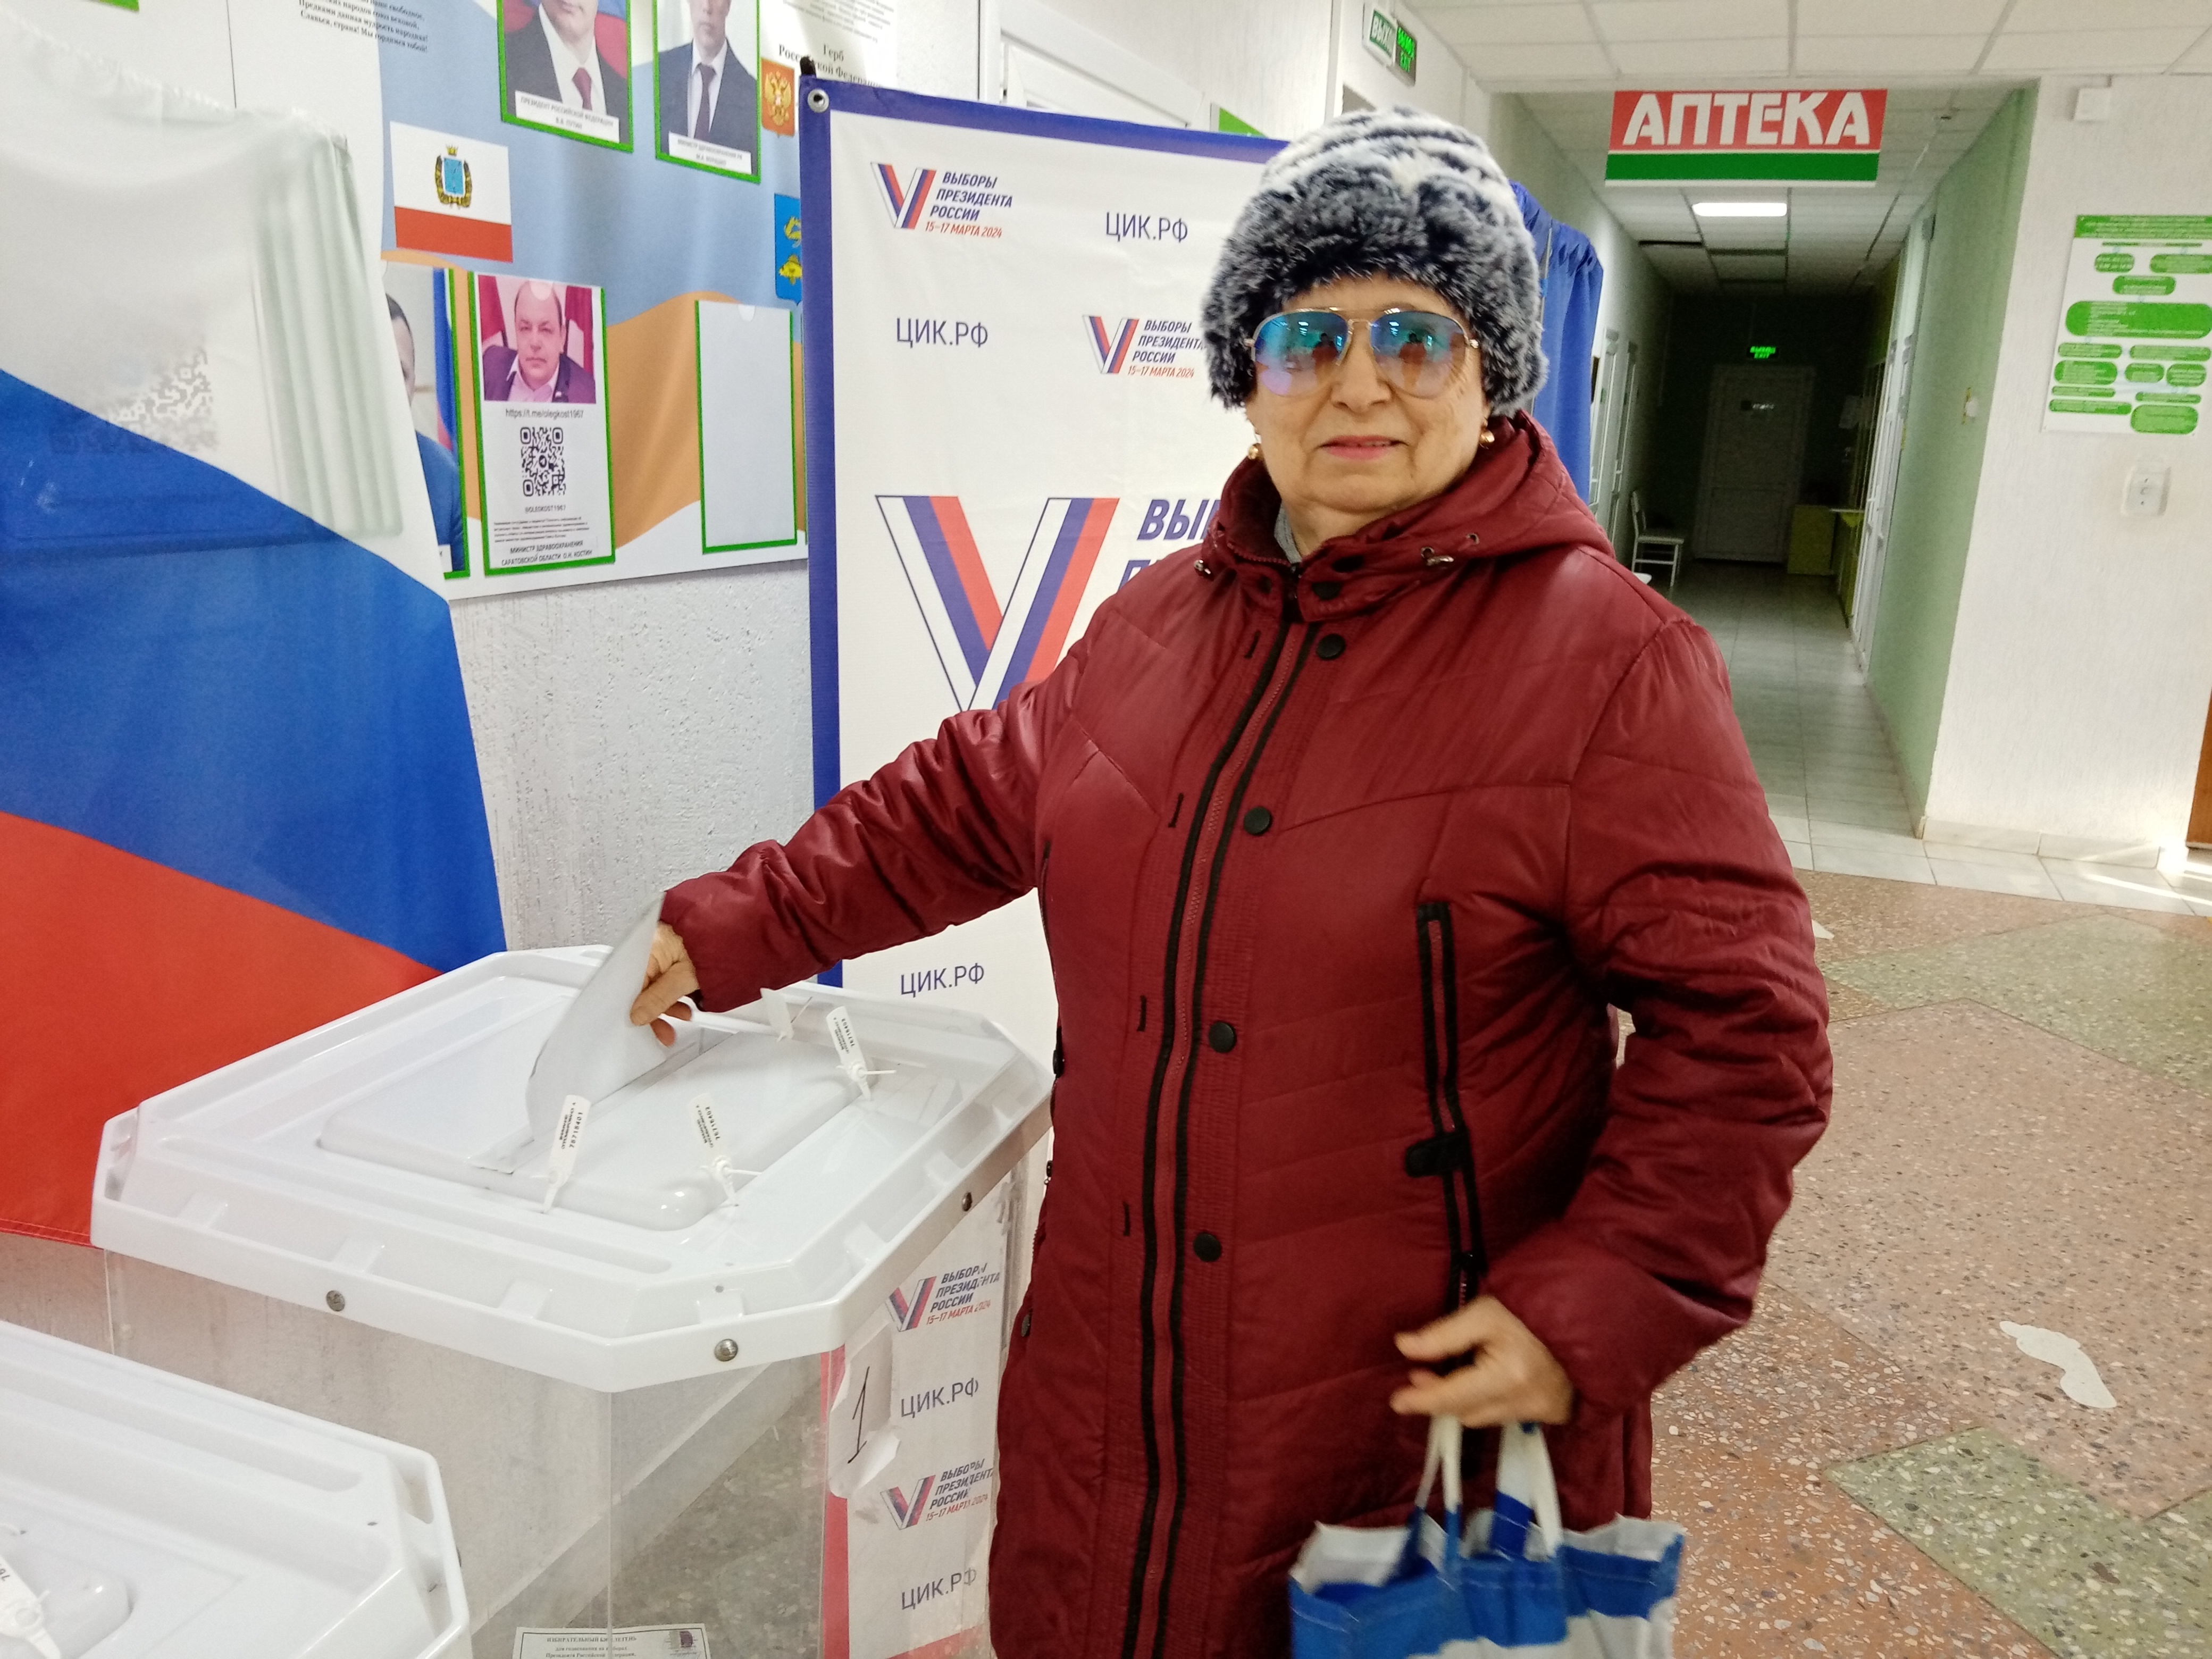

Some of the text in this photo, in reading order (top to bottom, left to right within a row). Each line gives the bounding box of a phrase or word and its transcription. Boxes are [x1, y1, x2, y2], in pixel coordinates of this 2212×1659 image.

[361, 27, 373, 38] Мы
[823, 44, 844, 62] Герб
[1622, 91, 1871, 146] АПТЕКА
[942, 172, 999, 189] ВЫБОРЫ
[936, 188, 1013, 208] ПРЕЗИДЕНТА
[929, 204, 981, 222] РОССИИ
[950, 224, 980, 237] МАРТА
[981, 227, 1003, 239] 2024
[1105, 211, 1188, 243] ЦИК.РФ
[896, 317, 988, 348] ЦИК.РФ
[1143, 320, 1193, 333] ВЫБОРЫ
[1132, 350, 1177, 364] РОССИИ
[1149, 366, 1176, 378] МАРТА
[1176, 368, 1195, 379] 2024
[501, 553, 538, 566] САРАТОВСКОЙ
[539, 553, 561, 562] ОБЛАСТИ
[573, 549, 593, 558] КОСТИН
[509, 545, 535, 554] МИНИСТР
[900, 962, 985, 998] ЦИК.РФ
[929, 1292, 974, 1313] РОССИИ
[948, 1304, 974, 1320] МАРТА
[901, 1377, 979, 1419] ЦИК.РФ
[847, 1365, 870, 1464] 1
[940, 1458, 985, 1482] ВЫБОРЫ
[971, 1493, 988, 1507] 2024
[901, 1566, 977, 1611] ЦИК.РФ
